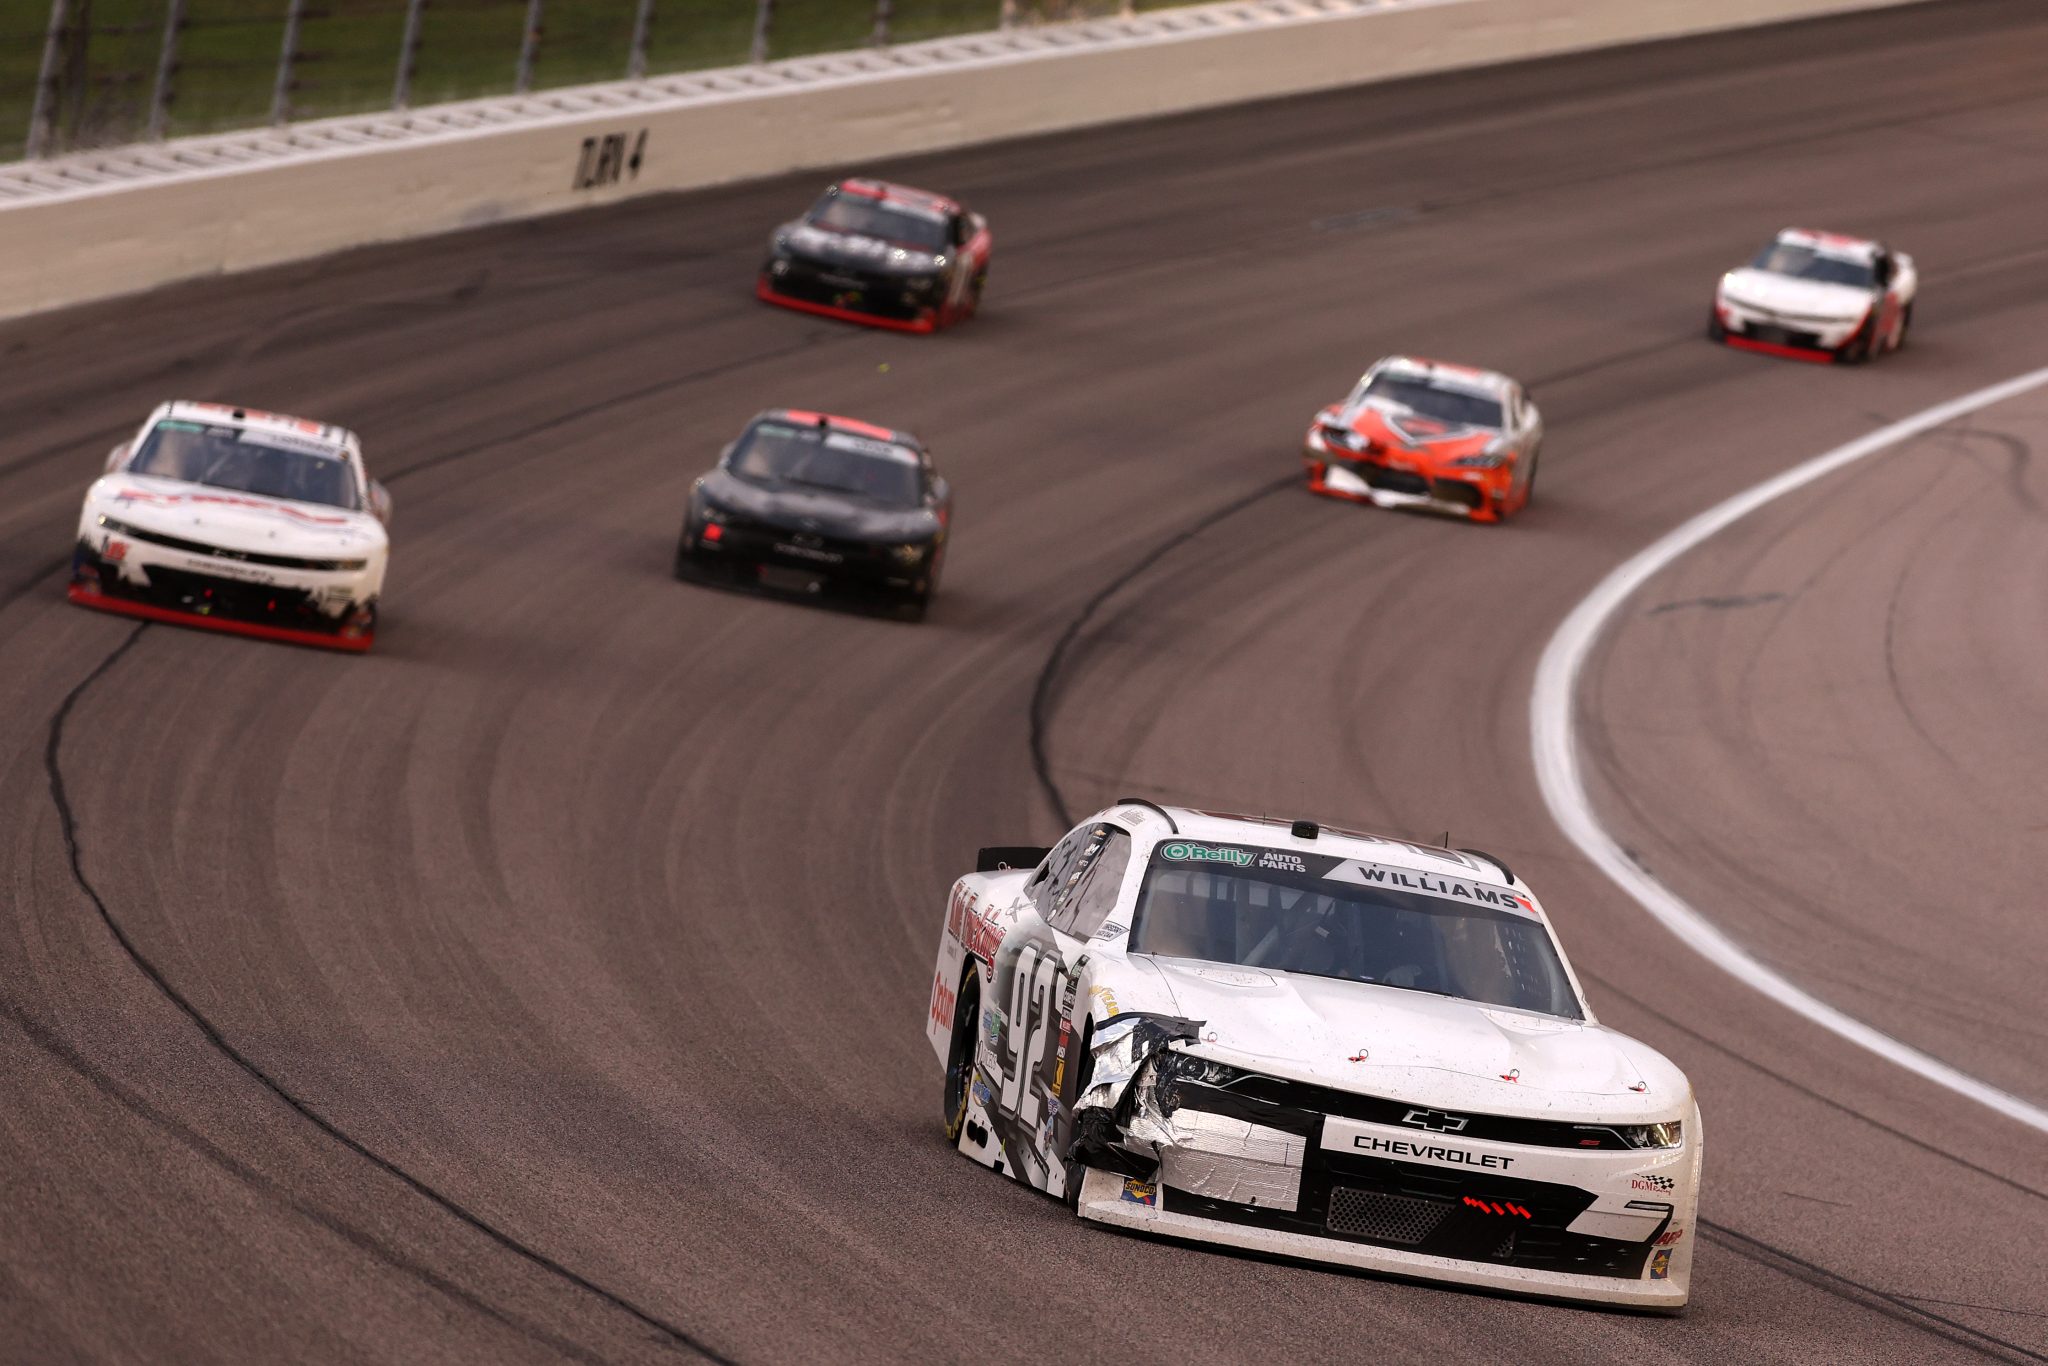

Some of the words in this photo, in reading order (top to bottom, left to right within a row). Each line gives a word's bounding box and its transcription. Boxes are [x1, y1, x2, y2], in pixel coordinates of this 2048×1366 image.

[1163, 843, 1254, 866] O'Reilly
[1263, 852, 1302, 864] AUTO
[1258, 859, 1306, 873] PARTS
[1358, 866, 1519, 909] WILLIAMS
[1001, 945, 1056, 1127] 92
[1353, 1135, 1515, 1170] CHEVROLET
[1125, 1181, 1156, 1195] SUNOCO
[1631, 1180, 1654, 1192] DGM
